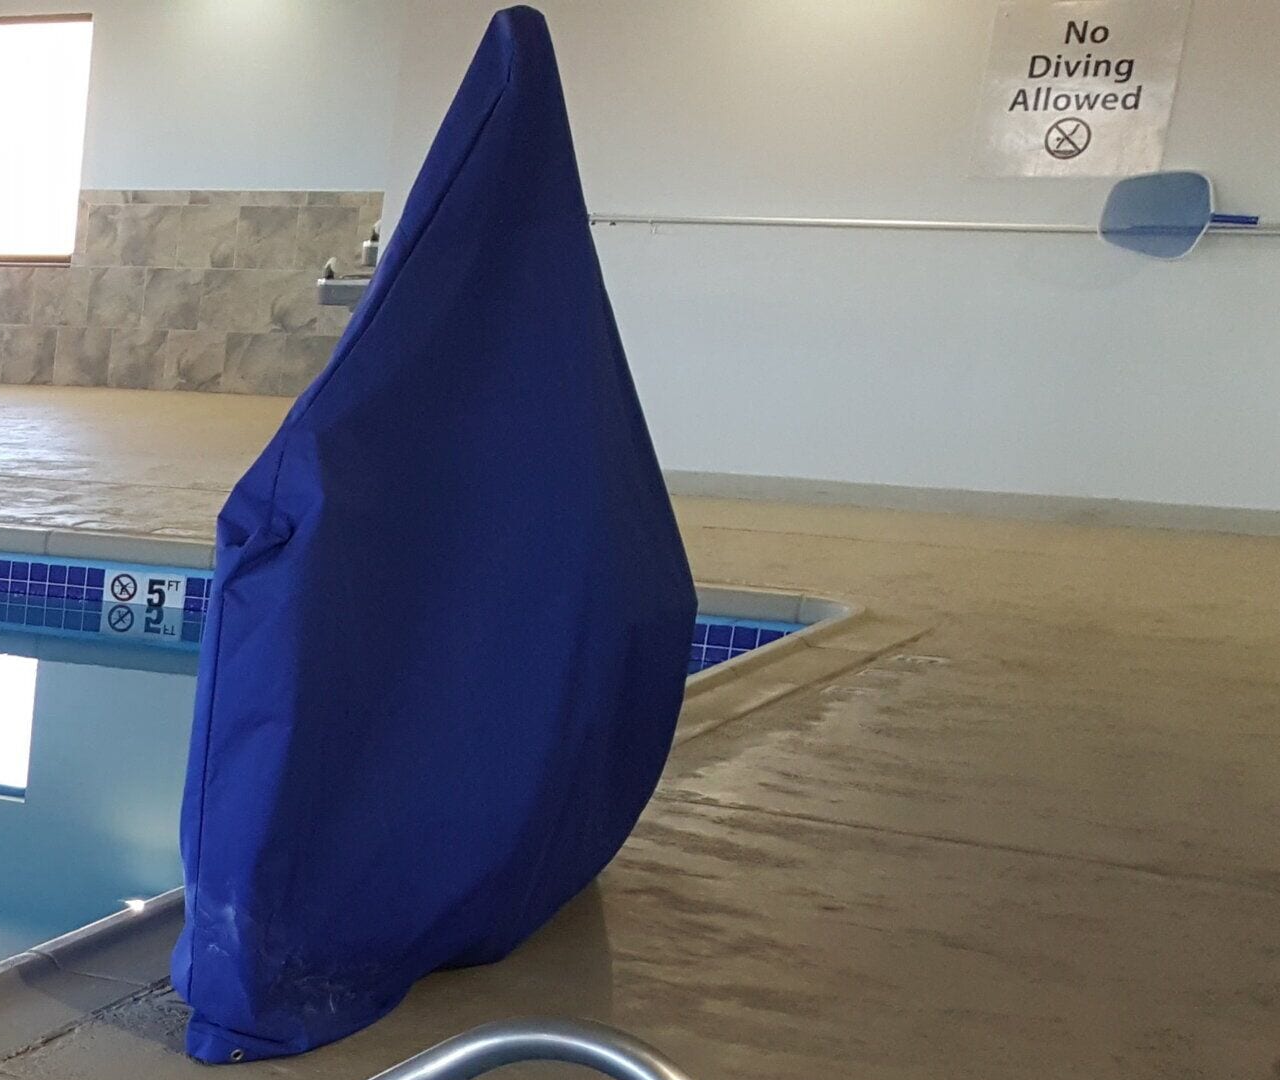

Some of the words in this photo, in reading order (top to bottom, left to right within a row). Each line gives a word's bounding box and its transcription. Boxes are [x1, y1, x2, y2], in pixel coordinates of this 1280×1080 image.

[1064, 20, 1109, 44] No
[1027, 53, 1135, 83] Diving
[1008, 85, 1142, 112] Allowed
[146, 578, 166, 607] 5
[167, 580, 181, 592] FT
